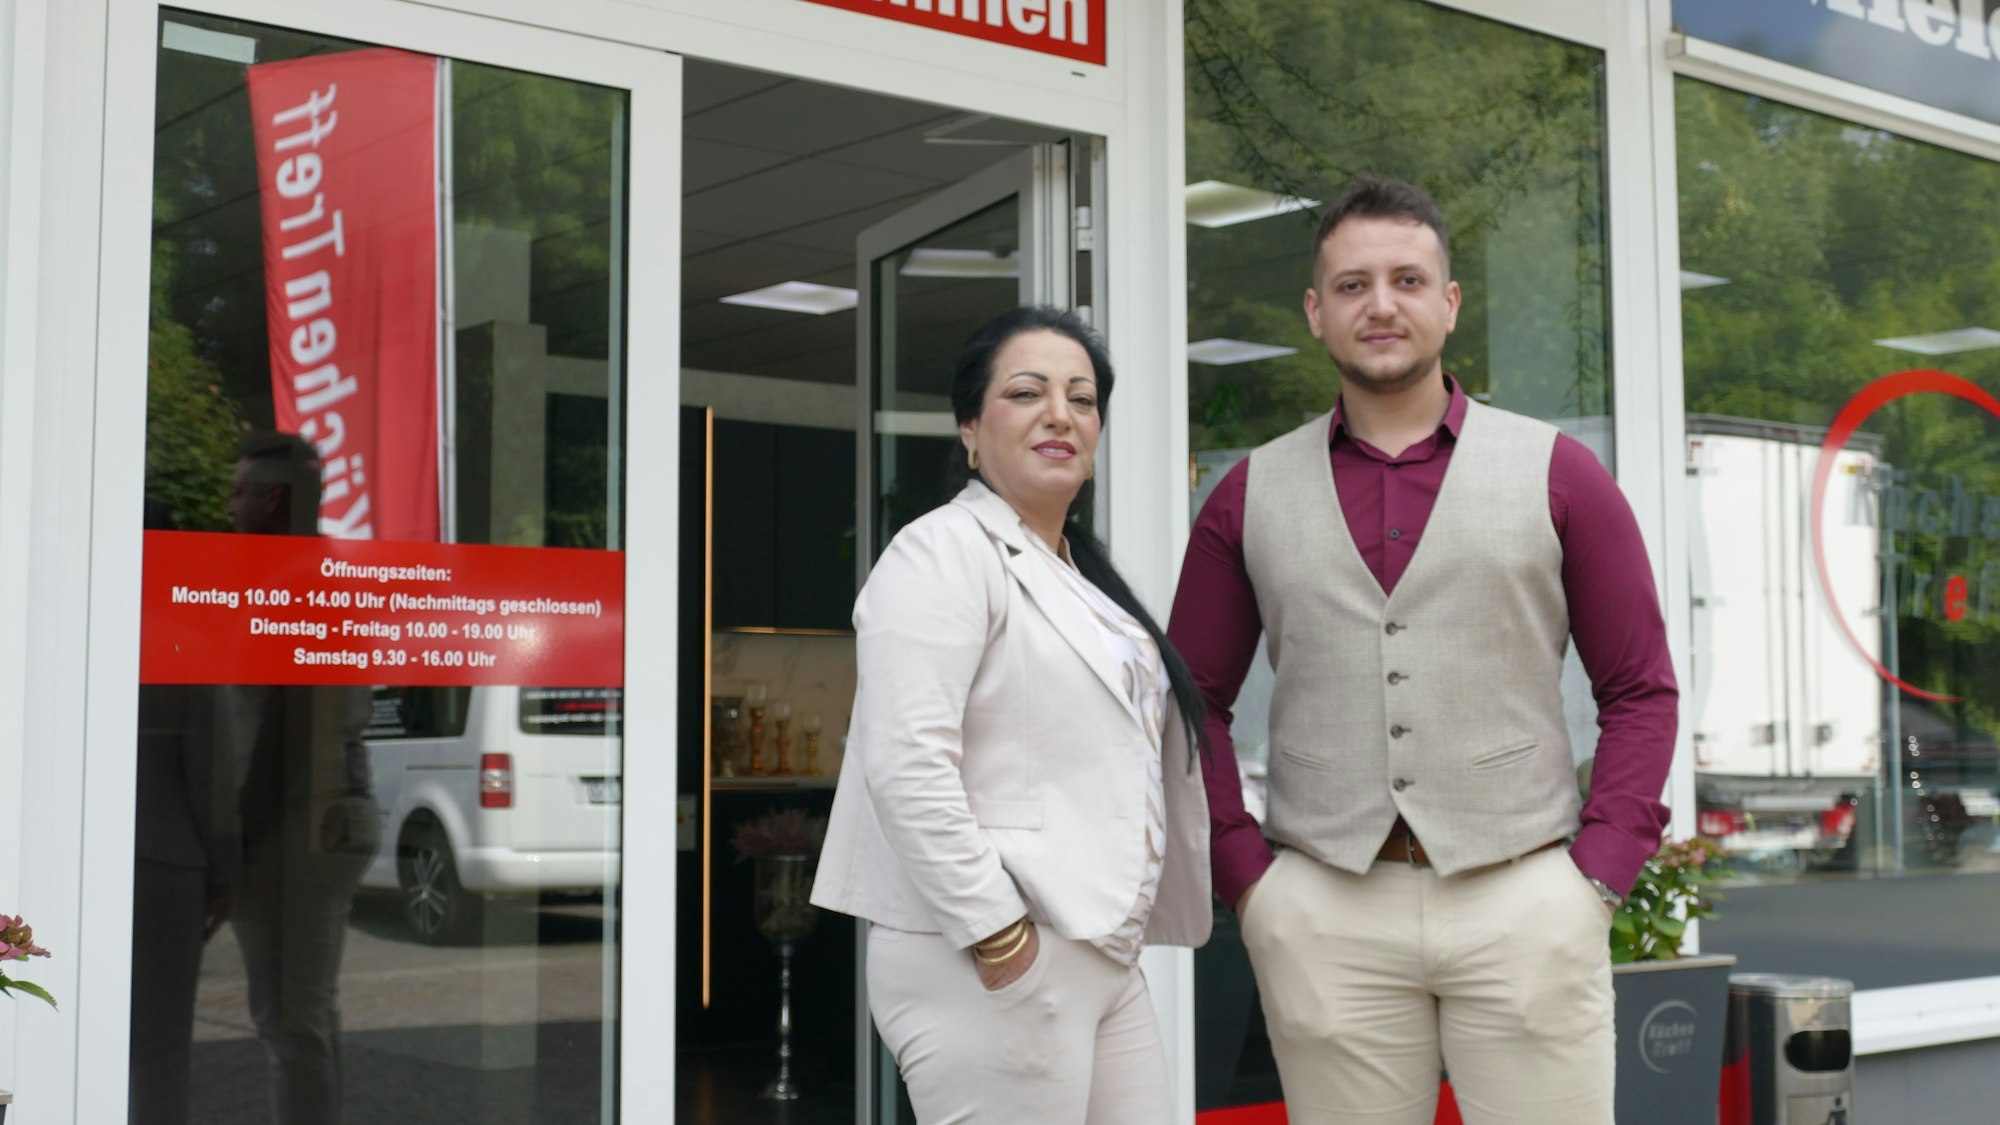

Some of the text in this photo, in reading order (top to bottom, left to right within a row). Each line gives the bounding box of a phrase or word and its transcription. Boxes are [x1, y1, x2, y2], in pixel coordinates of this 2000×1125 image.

[320, 557, 452, 583] Öffnungszeiten:
[172, 586, 239, 608] Montag
[244, 588, 291, 606] 10.00
[306, 590, 350, 607] 14.00
[355, 592, 386, 609] Uhr
[389, 592, 496, 615] (Nachmittags
[499, 597, 602, 618] geschlossen)
[250, 618, 327, 639] Dienstag
[342, 620, 400, 641] Freitag
[405, 622, 448, 638] 10.00
[462, 623, 502, 640] 19.00
[507, 624, 535, 640] Uhr
[293, 647, 368, 669] Samstag
[372, 649, 406, 666] 9.30
[421, 650, 463, 667] 16.00
[467, 651, 497, 667] Uhr
